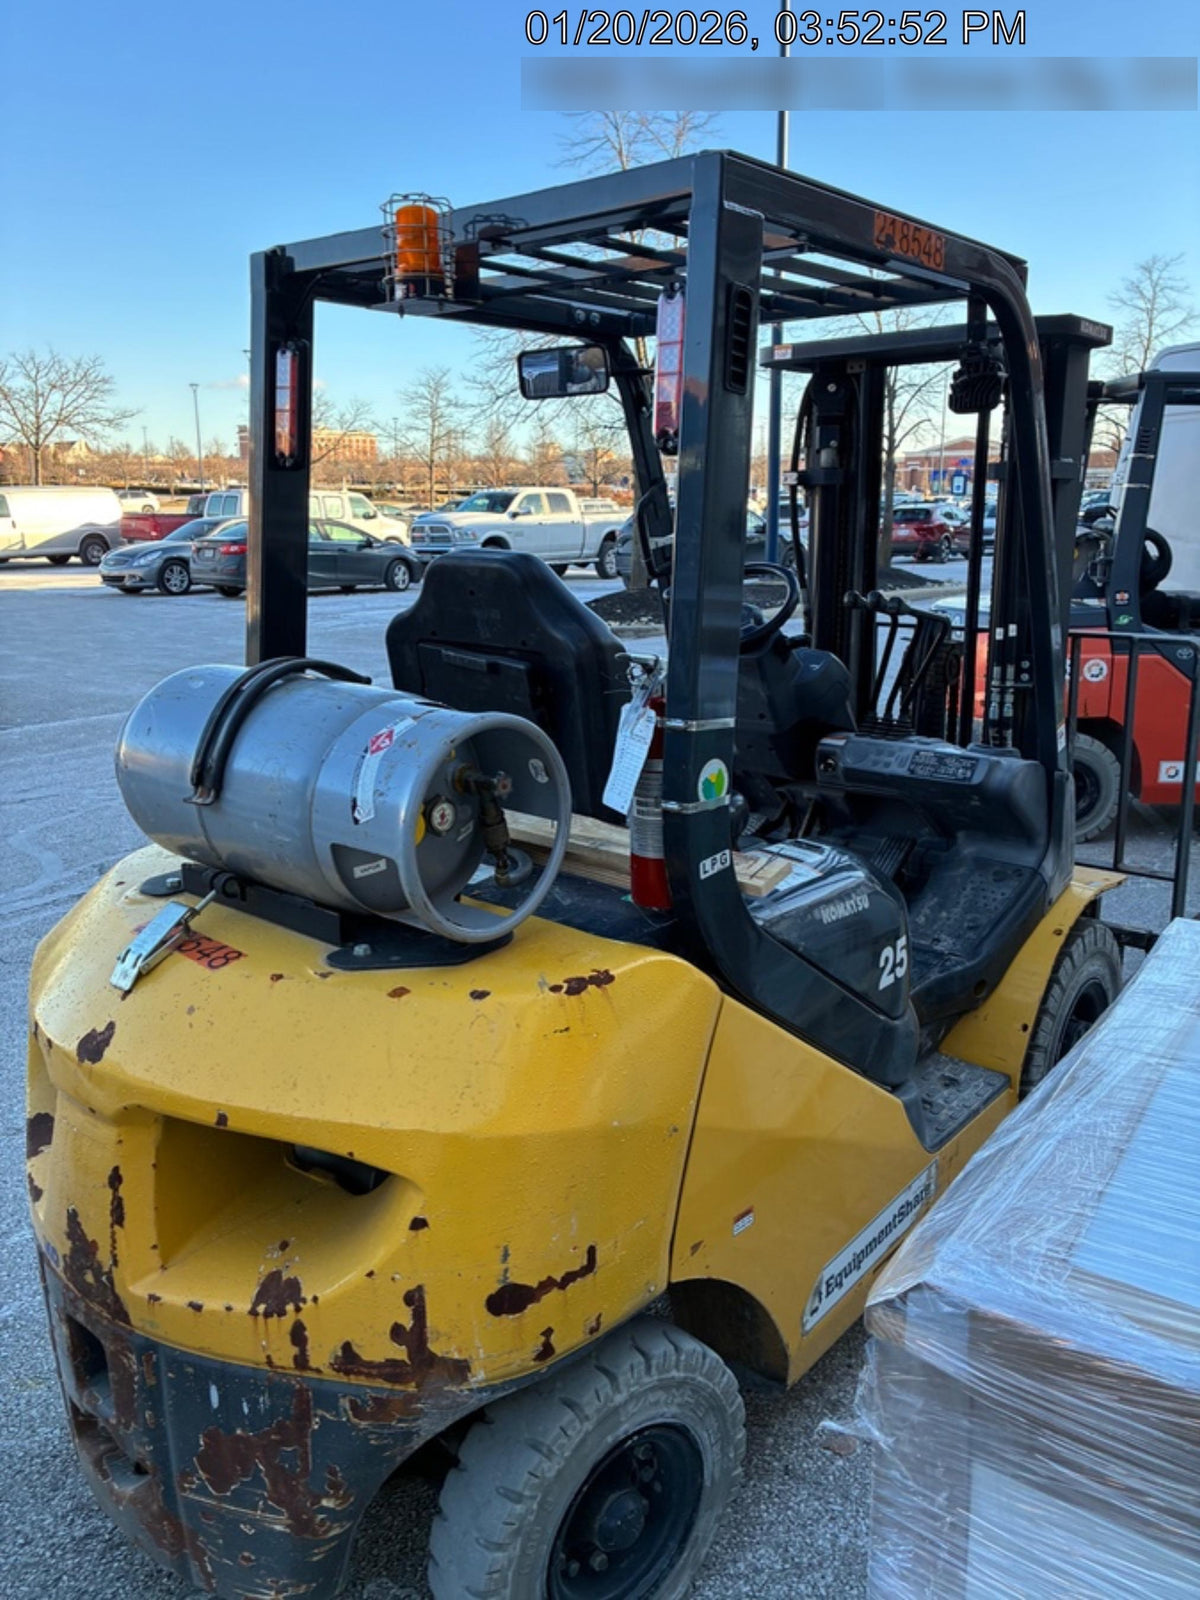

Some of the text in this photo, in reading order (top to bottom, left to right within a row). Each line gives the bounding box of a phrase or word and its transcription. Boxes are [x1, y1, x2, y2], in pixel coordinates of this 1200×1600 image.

[702, 852, 728, 875] LPG
[821, 893, 870, 925] KOMATSU
[878, 934, 908, 991] 25
[824, 1182, 932, 1298] EquipmentShare
